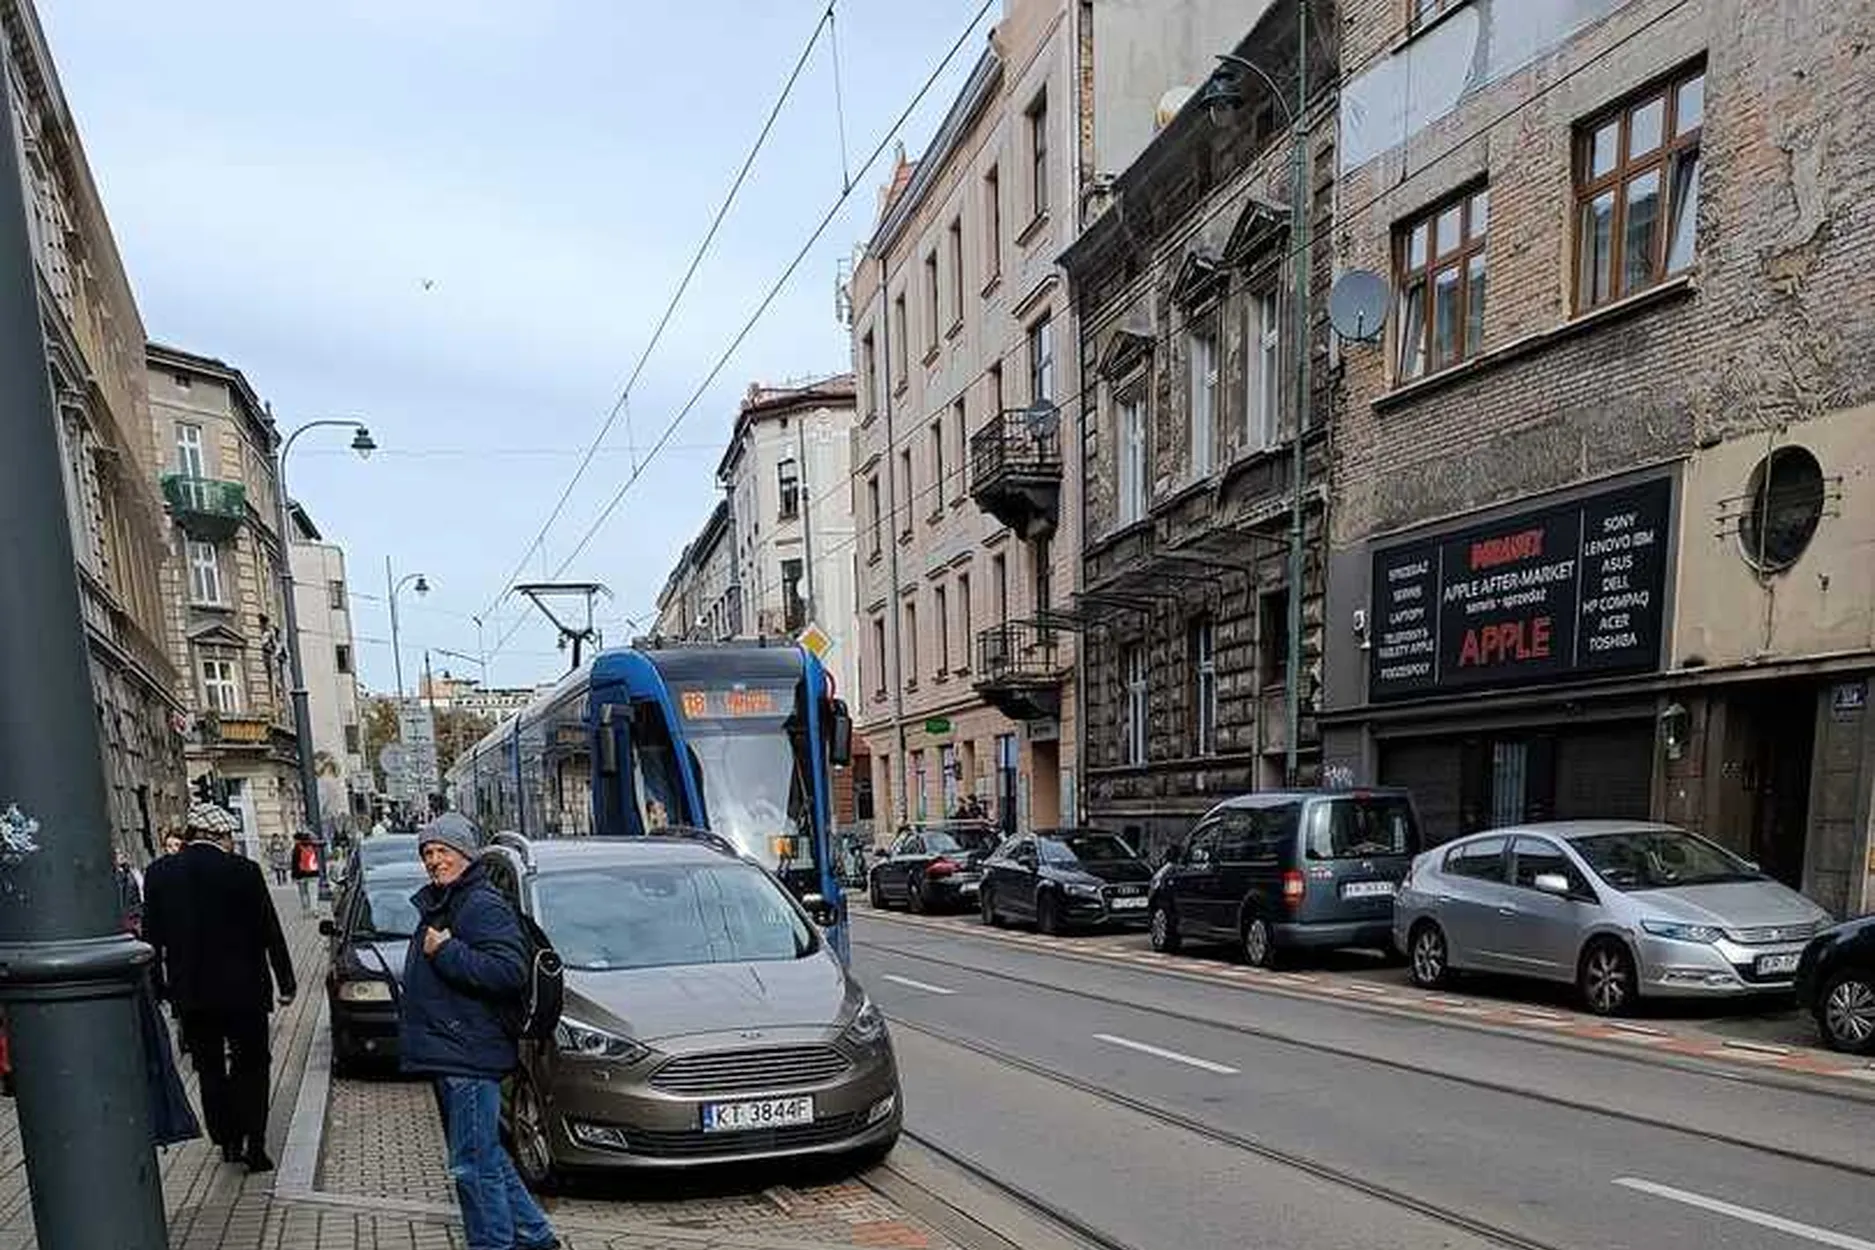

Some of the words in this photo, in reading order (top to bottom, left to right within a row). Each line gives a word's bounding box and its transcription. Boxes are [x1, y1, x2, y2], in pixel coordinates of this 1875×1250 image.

[1603, 511, 1638, 532] SONY
[1585, 533, 1631, 556] LENOVO
[1601, 554, 1633, 573] ASUS
[1443, 580, 1480, 603] APPLE
[1602, 575, 1630, 591] DELL
[1599, 613, 1630, 631] ACER
[1459, 617, 1550, 667] APPLE
[1589, 632, 1638, 652] TOSHIBA
[716, 1106, 741, 1126] KT
[750, 1100, 808, 1122] 3844F
